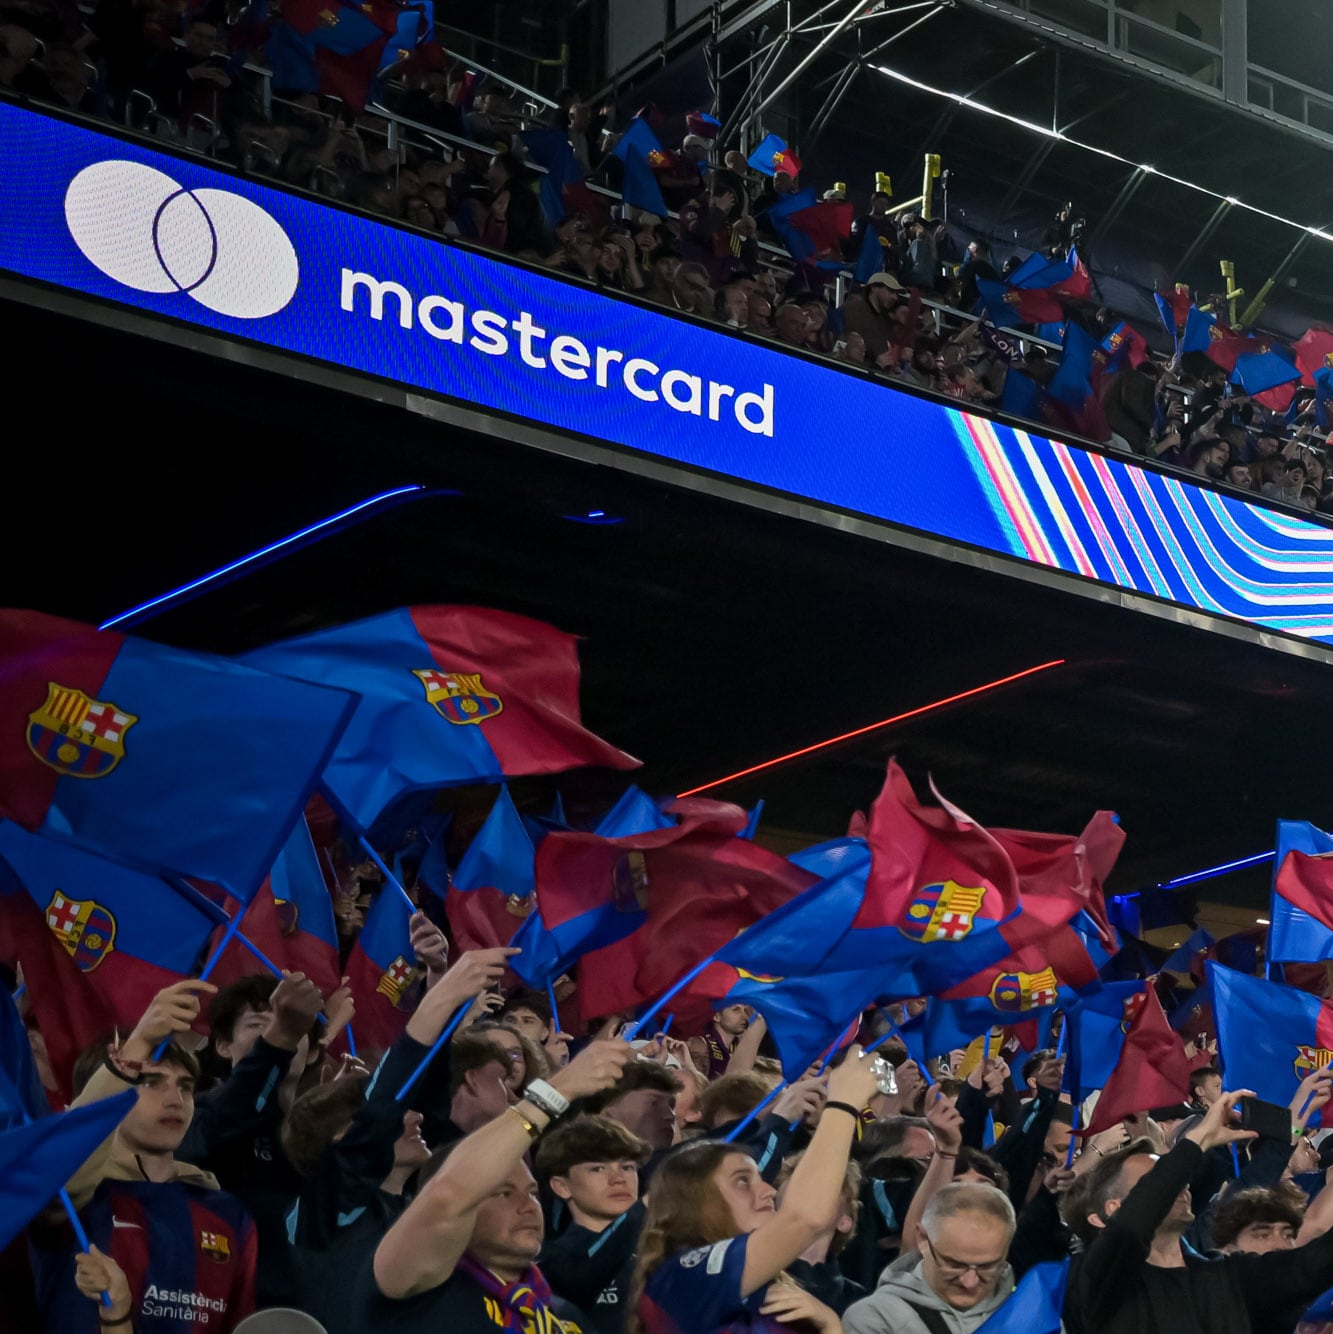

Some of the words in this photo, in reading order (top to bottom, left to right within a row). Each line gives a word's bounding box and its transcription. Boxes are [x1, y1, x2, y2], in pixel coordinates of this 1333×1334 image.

[340, 267, 775, 438] mastercard
[141, 1300, 209, 1323] Sanitària
[144, 1284, 227, 1312] Assistènci
